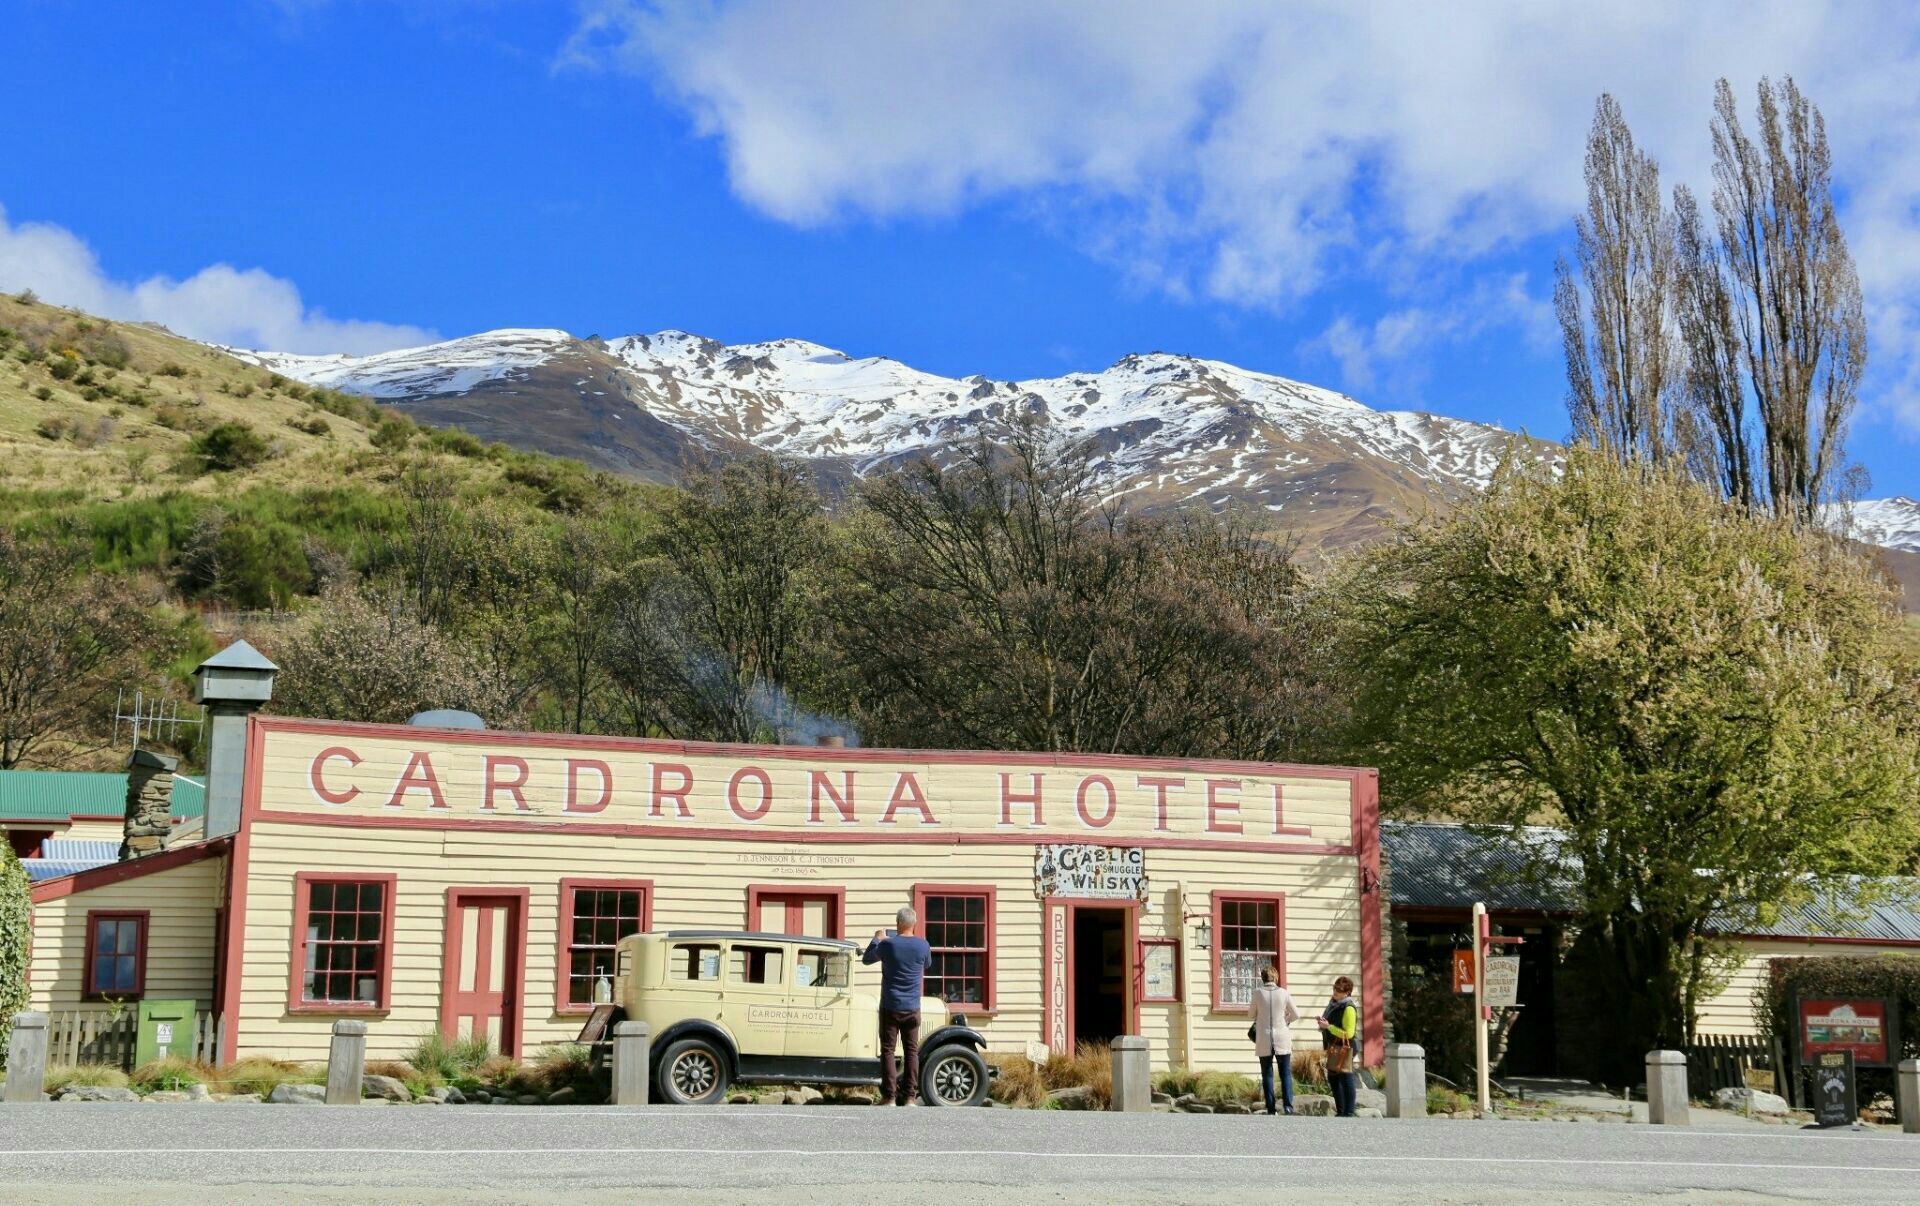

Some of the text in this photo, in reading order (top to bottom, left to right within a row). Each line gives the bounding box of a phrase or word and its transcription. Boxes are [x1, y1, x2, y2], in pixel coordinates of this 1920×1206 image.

[309, 746, 1313, 838] CARDRONA HOTEL
[1059, 848, 1141, 870] GAELIC
[1071, 873, 1142, 890] WHISKY
[1054, 913, 1064, 1055] RESTAURAN
[752, 1010, 829, 1021] CARDRONA HOTEL
